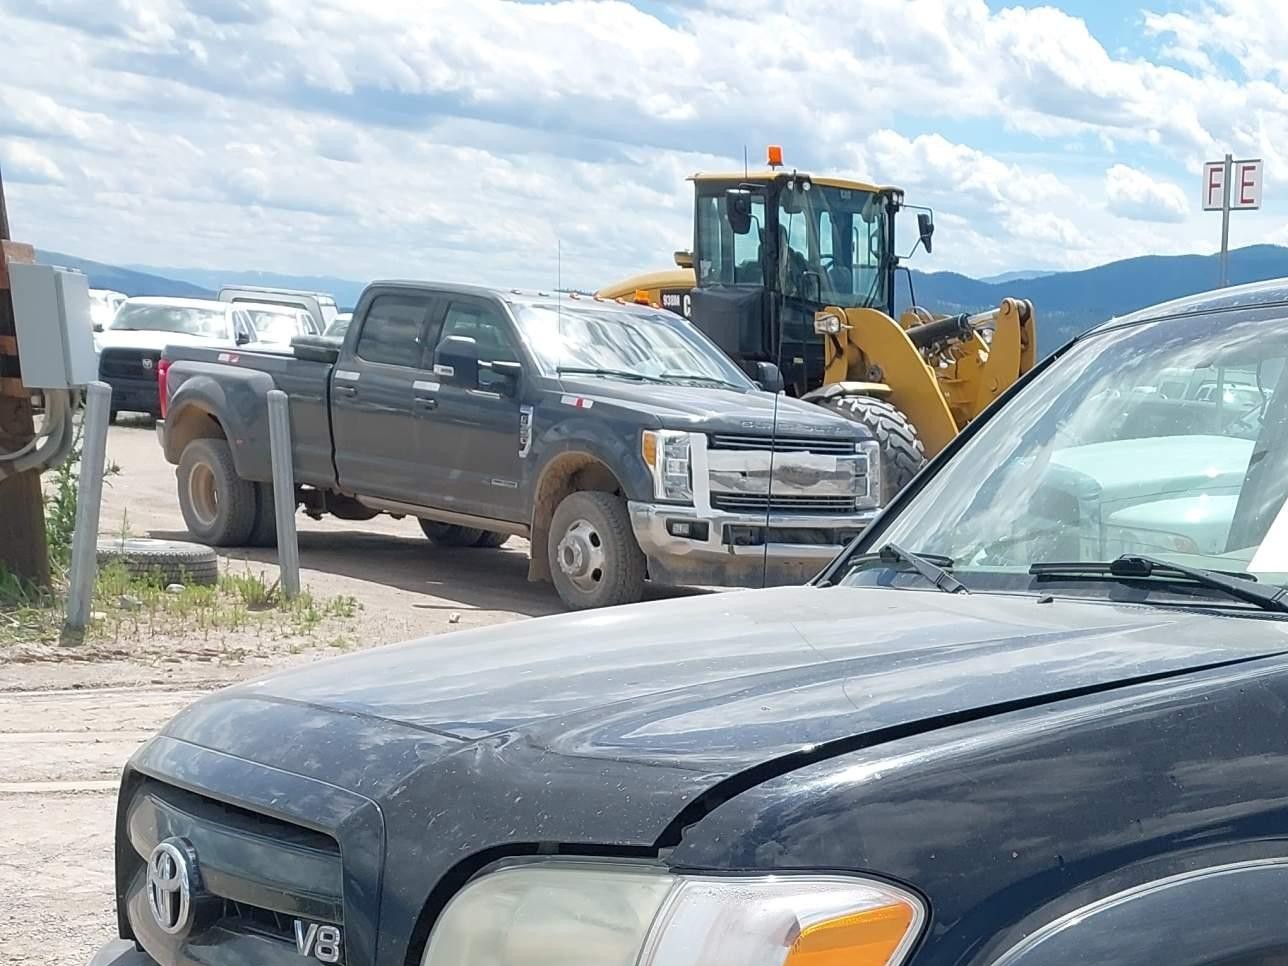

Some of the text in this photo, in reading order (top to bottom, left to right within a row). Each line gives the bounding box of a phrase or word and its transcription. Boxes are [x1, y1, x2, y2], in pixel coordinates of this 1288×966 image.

[1208, 167, 1223, 205] F
[1240, 165, 1257, 204] E
[294, 919, 342, 964] V8
